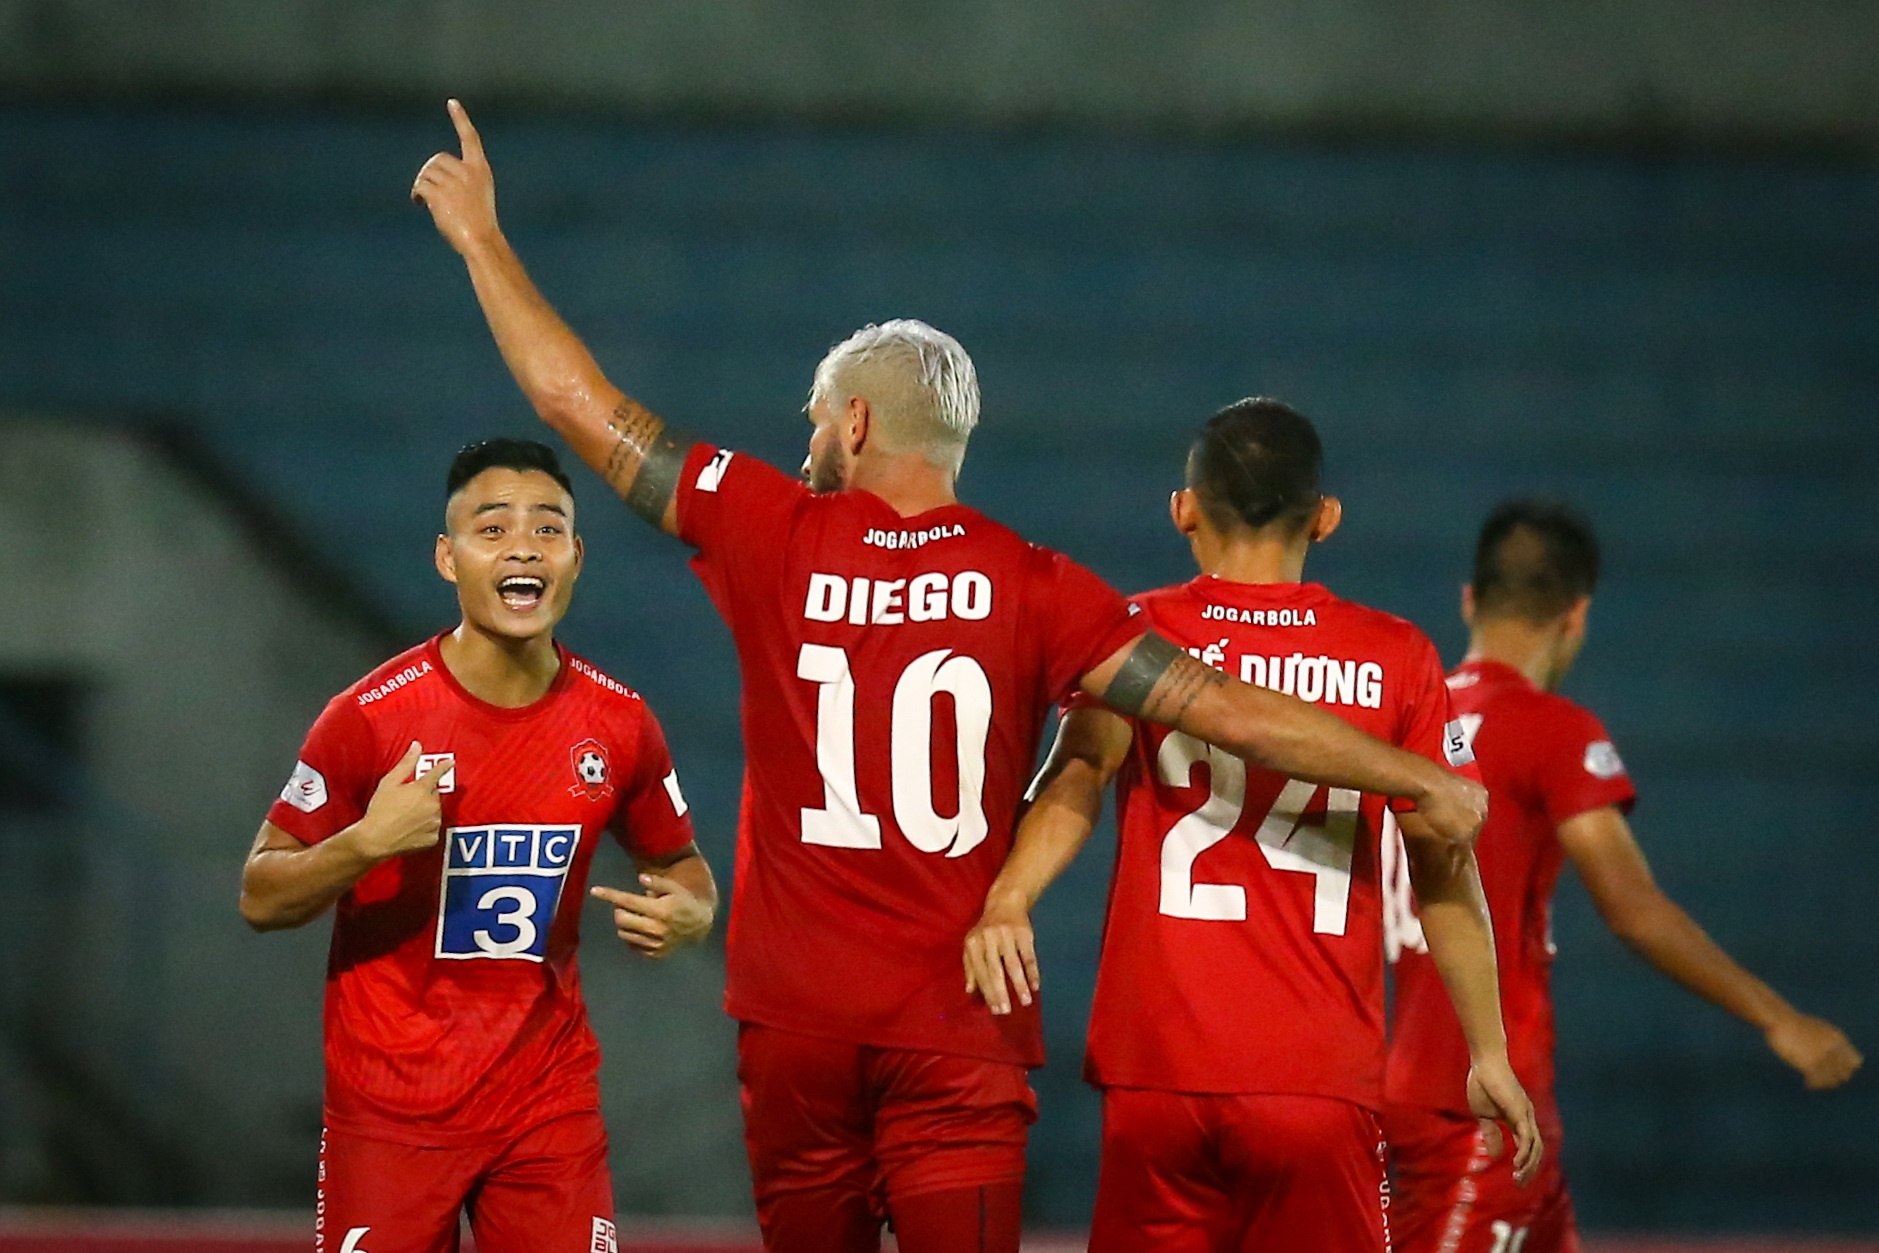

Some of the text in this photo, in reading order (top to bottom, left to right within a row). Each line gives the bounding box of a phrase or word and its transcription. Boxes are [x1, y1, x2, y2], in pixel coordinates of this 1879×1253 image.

[863, 524, 966, 550] JOGARBOLA
[803, 570, 993, 625] DIEGO
[1201, 604, 1317, 626] JOGARBOLA
[357, 660, 433, 706] JOGARBOLA
[570, 657, 641, 701] JOGARBOLA
[796, 643, 993, 858] 10
[457, 834, 569, 864] VTC
[1157, 730, 1361, 936] 24
[472, 886, 538, 956] 3
